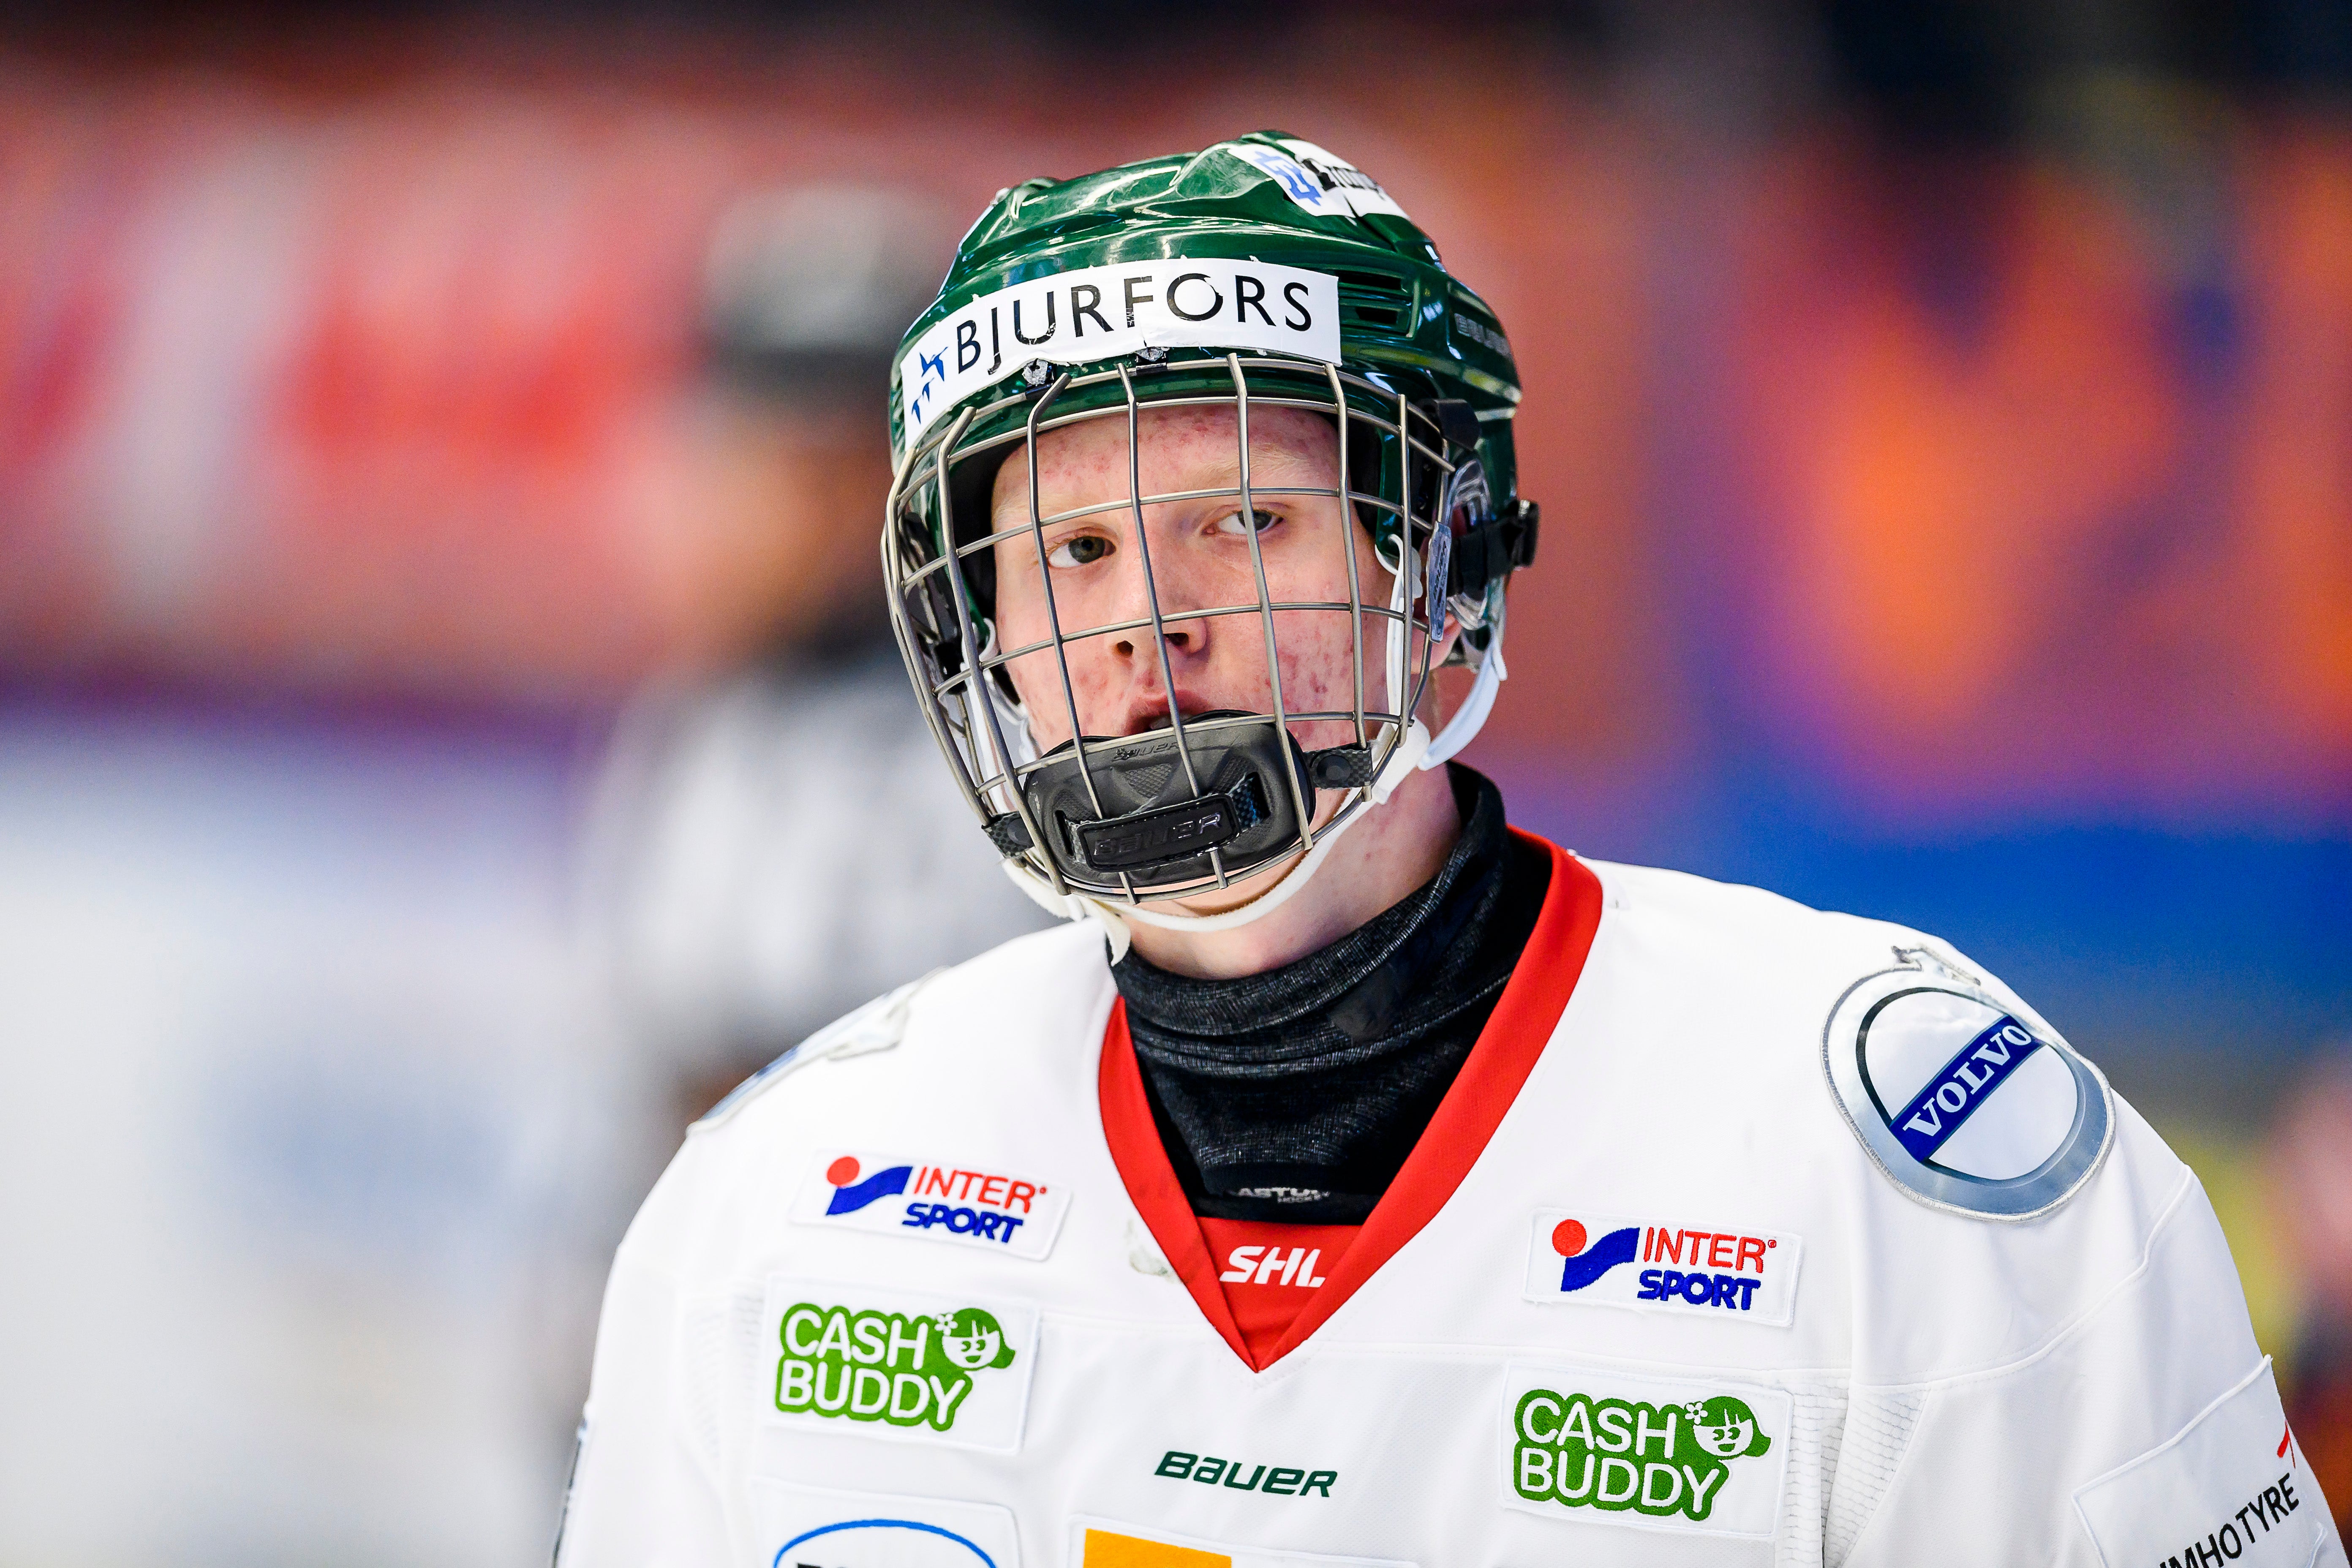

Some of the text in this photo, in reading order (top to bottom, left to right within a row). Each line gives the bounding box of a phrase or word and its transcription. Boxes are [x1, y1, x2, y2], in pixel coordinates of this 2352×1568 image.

[956, 272, 1312, 375] BJURFORS
[1902, 1025, 2032, 1137] VOLVO
[914, 1166, 1037, 1214] INTER
[902, 1202, 1024, 1243] SPORT
[1643, 1226, 1766, 1274] INTER
[1220, 1246, 1326, 1288] SHL
[1637, 1269, 1761, 1311] SPORT
[785, 1309, 929, 1370] CASH
[779, 1359, 966, 1425] BUDDY
[1522, 1397, 1677, 1459] CASH
[1520, 1447, 1720, 1514] BUDDY
